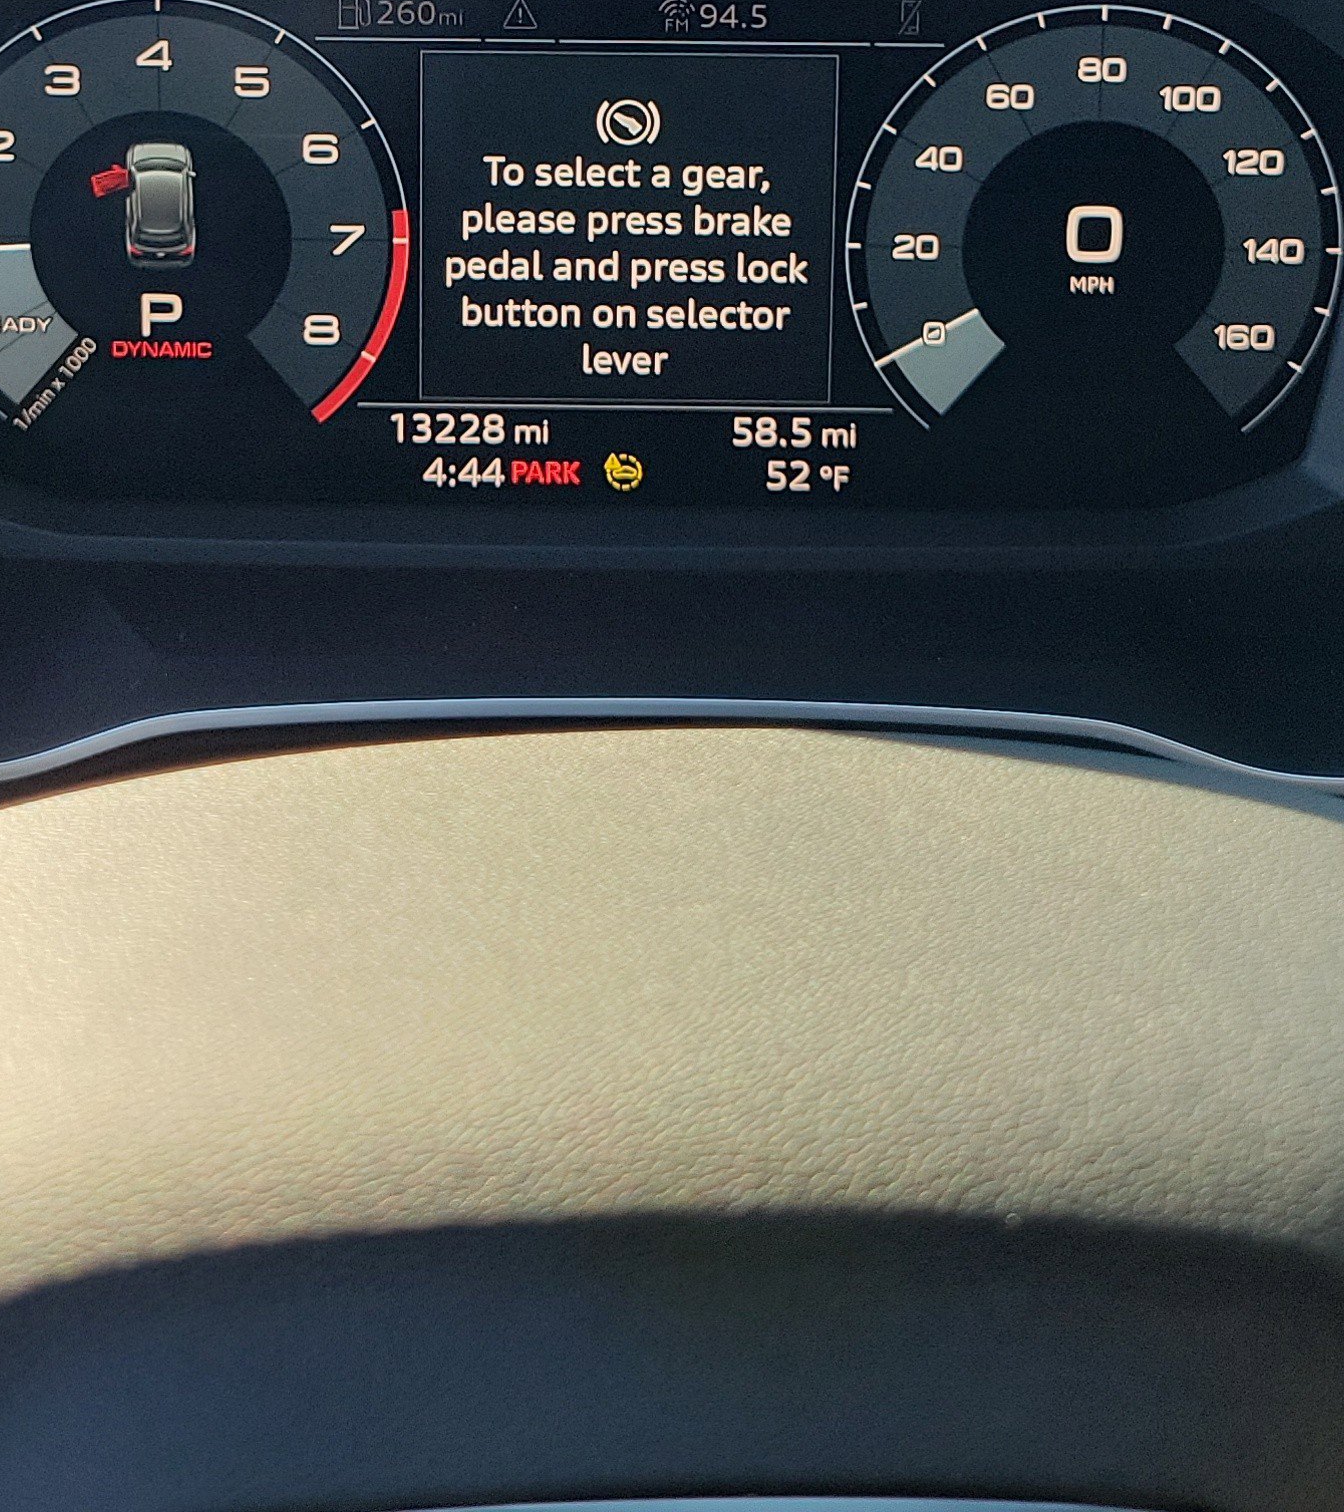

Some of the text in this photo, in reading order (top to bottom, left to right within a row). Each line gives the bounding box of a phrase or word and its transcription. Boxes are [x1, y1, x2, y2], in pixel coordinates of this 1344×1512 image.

[664, 18, 690, 32] FM
[699, 3, 768, 29] 94.5
[136, 40, 173, 71] 4
[1077, 57, 1127, 83] 80
[44, 65, 81, 96] 3
[234, 66, 270, 98] 5
[986, 84, 1035, 110] 60
[1159, 85, 1221, 112] 100
[302, 133, 339, 165] 6
[915, 146, 963, 172] 40
[1222, 149, 1285, 176] 120
[482, 155, 771, 196] To select a gear,
[461, 202, 792, 243] please press brake
[1066, 205, 1123, 264] 0
[329, 224, 365, 256] 7
[892, 234, 940, 261] 20
[1243, 238, 1305, 265] 140
[445, 249, 809, 290] pedal and press lock
[1069, 275, 1115, 295] MPH
[141, 293, 183, 338] P
[461, 295, 791, 331] button on selector
[303, 314, 340, 346] 8
[1213, 324, 1276, 352] 160
[58, 337, 97, 379] 1000
[112, 340, 213, 359] DYNAMIC
[582, 342, 669, 375] lever
[390, 412, 550, 445] 13228 mi
[732, 416, 858, 449] 58.5 mi
[422, 456, 506, 488] 4:44
[511, 460, 581, 485] PARK
[766, 460, 811, 492] 52
